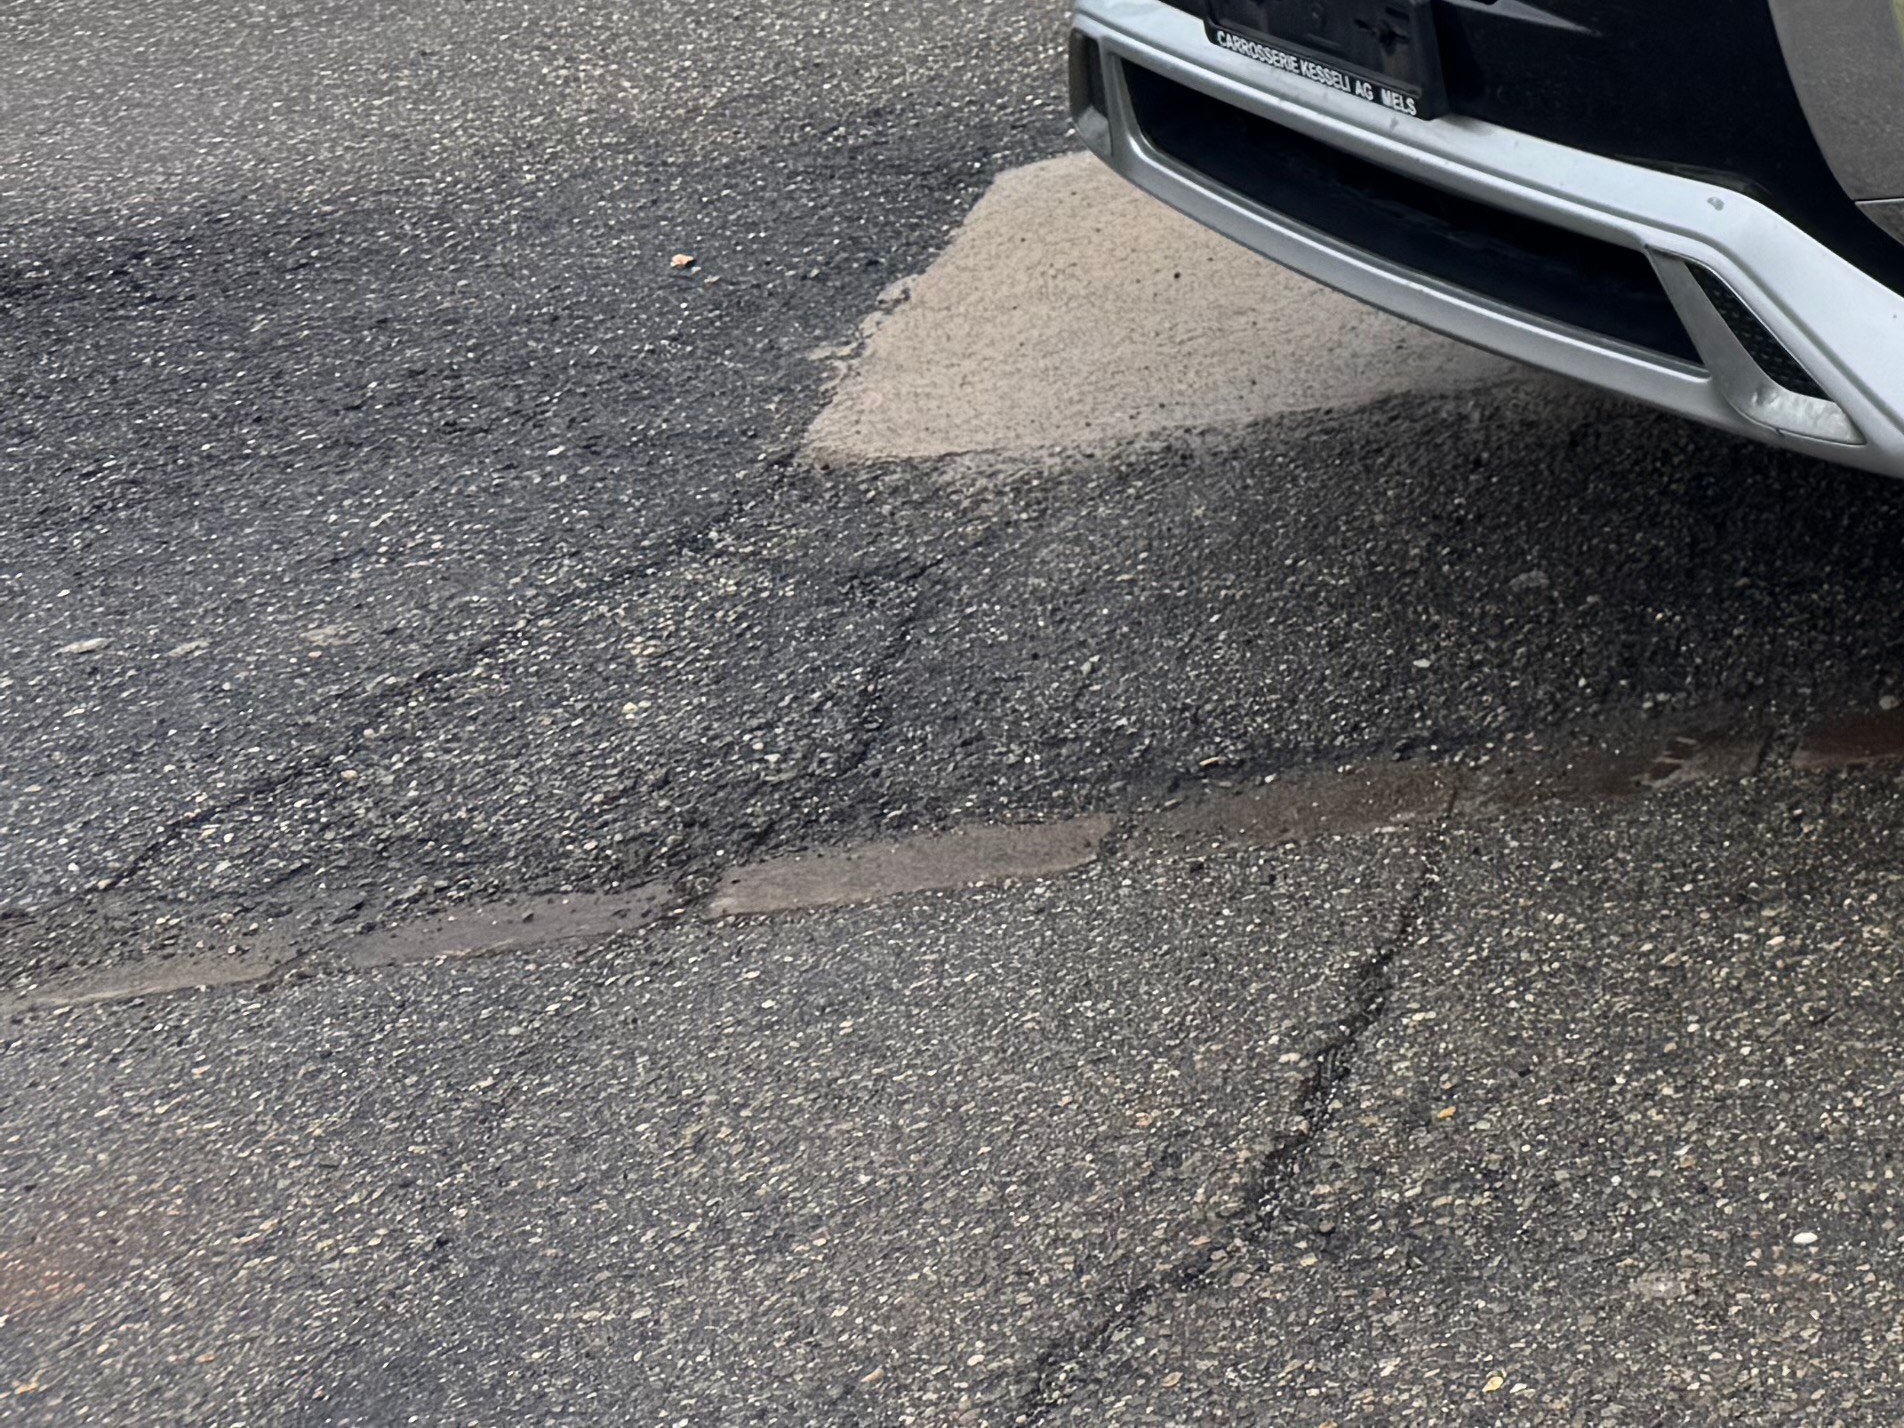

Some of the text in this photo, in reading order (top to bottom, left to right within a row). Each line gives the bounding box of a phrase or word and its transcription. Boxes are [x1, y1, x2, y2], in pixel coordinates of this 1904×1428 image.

[1216, 30, 1417, 116] CARROSSERIE KESSELI AG MELS
